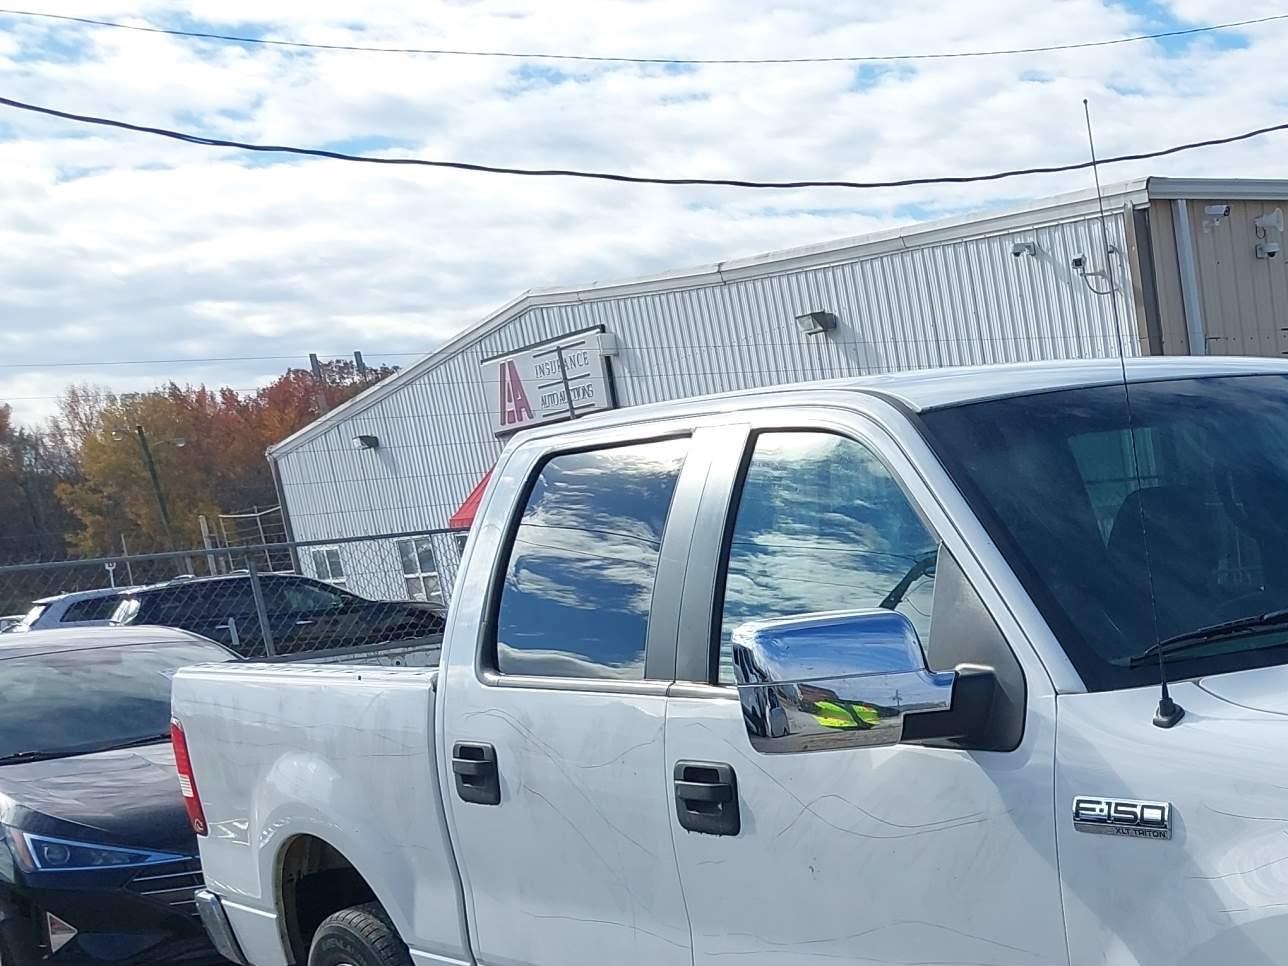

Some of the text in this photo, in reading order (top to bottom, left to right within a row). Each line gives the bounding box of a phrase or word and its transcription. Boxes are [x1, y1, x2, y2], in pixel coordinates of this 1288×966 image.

[560, 384, 594, 404] AUTIONS
[1115, 827, 1167, 839] XLT TRITON
